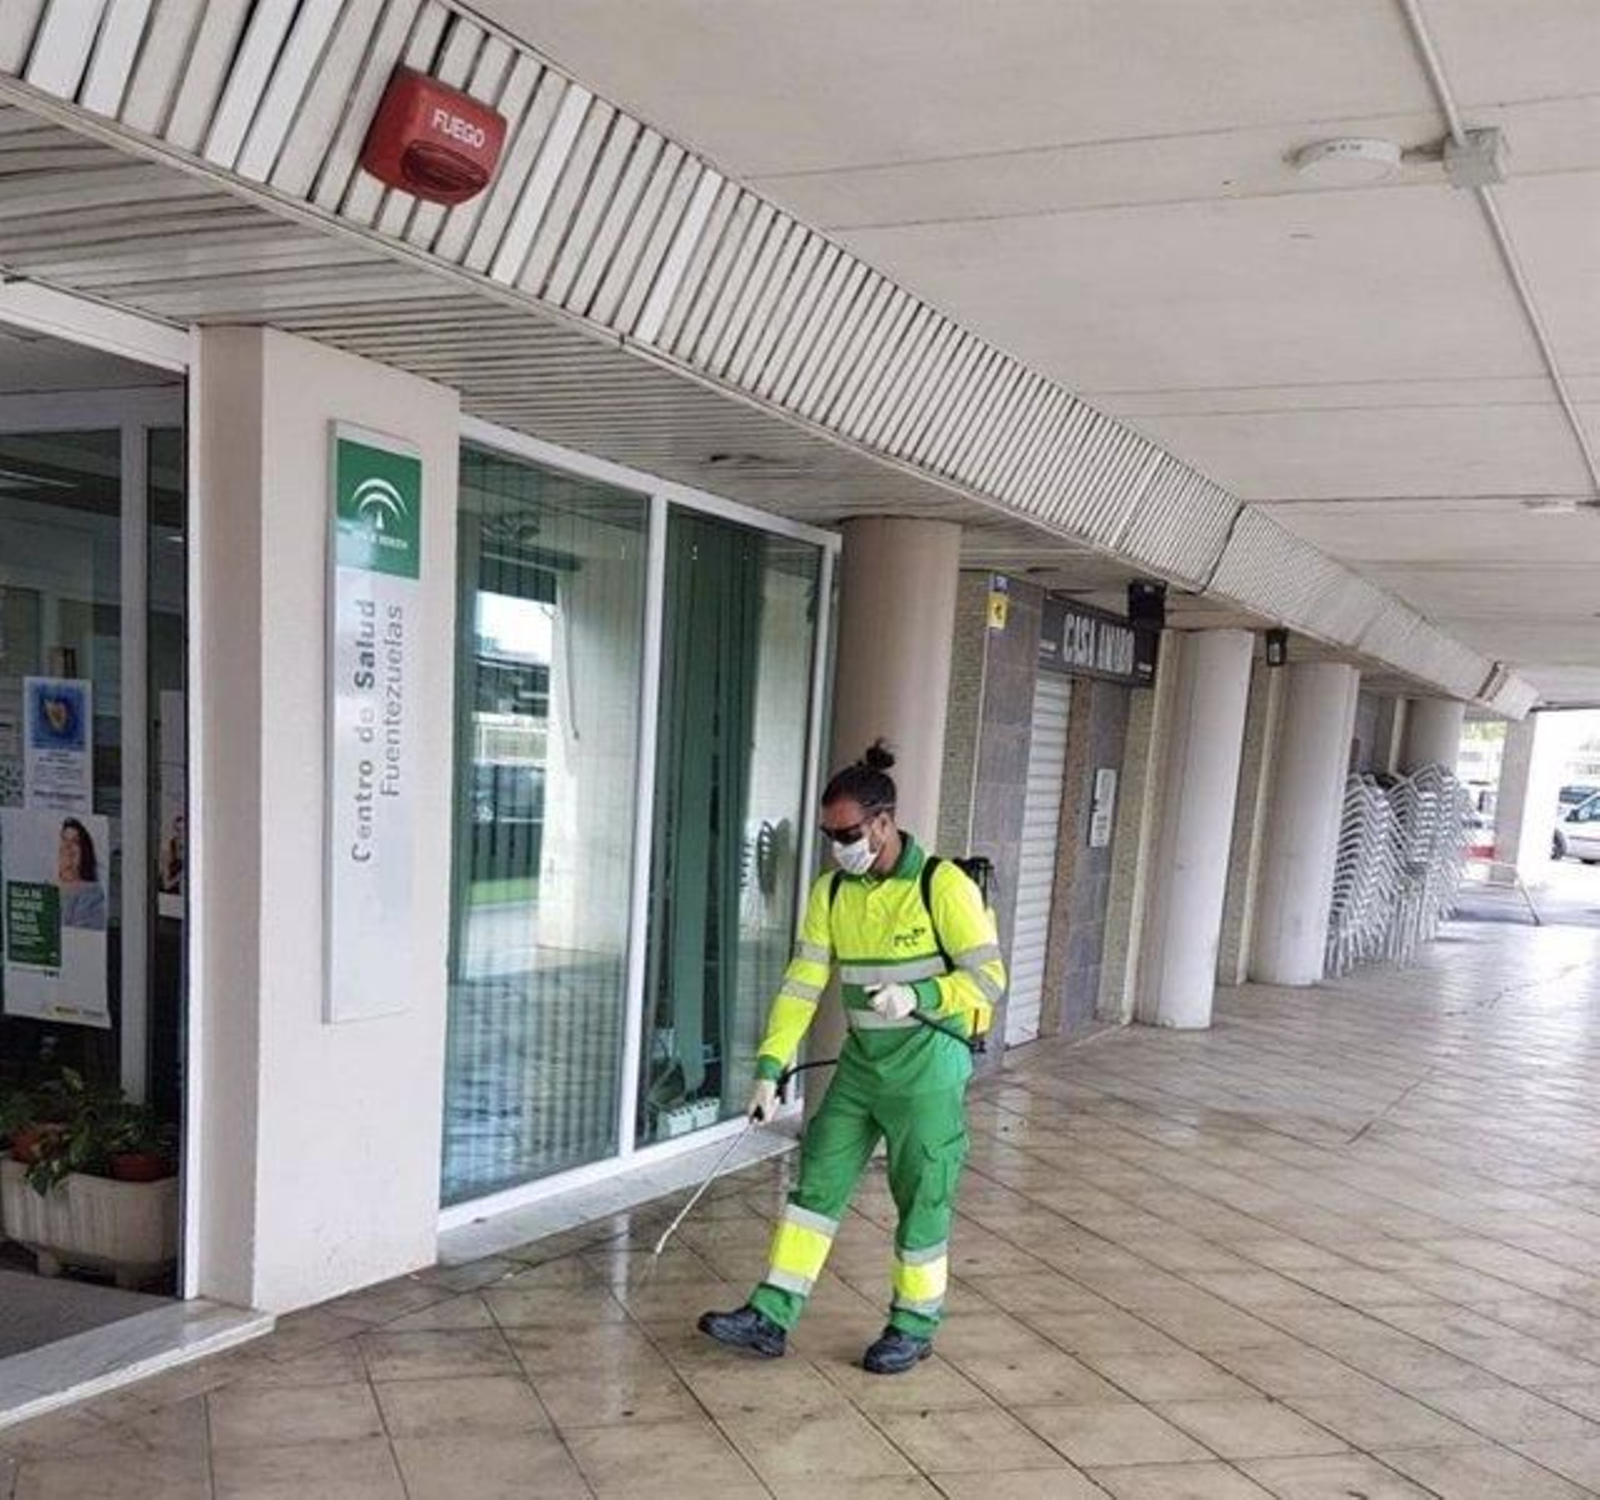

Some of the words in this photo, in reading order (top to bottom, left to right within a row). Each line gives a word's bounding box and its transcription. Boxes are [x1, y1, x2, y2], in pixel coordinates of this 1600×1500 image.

[432, 109, 485, 148] FUEGO
[354, 599, 375, 689] Salud
[353, 707, 375, 743] de
[380, 605, 402, 797] Fuentezuelas
[351, 760, 373, 862] Centro
